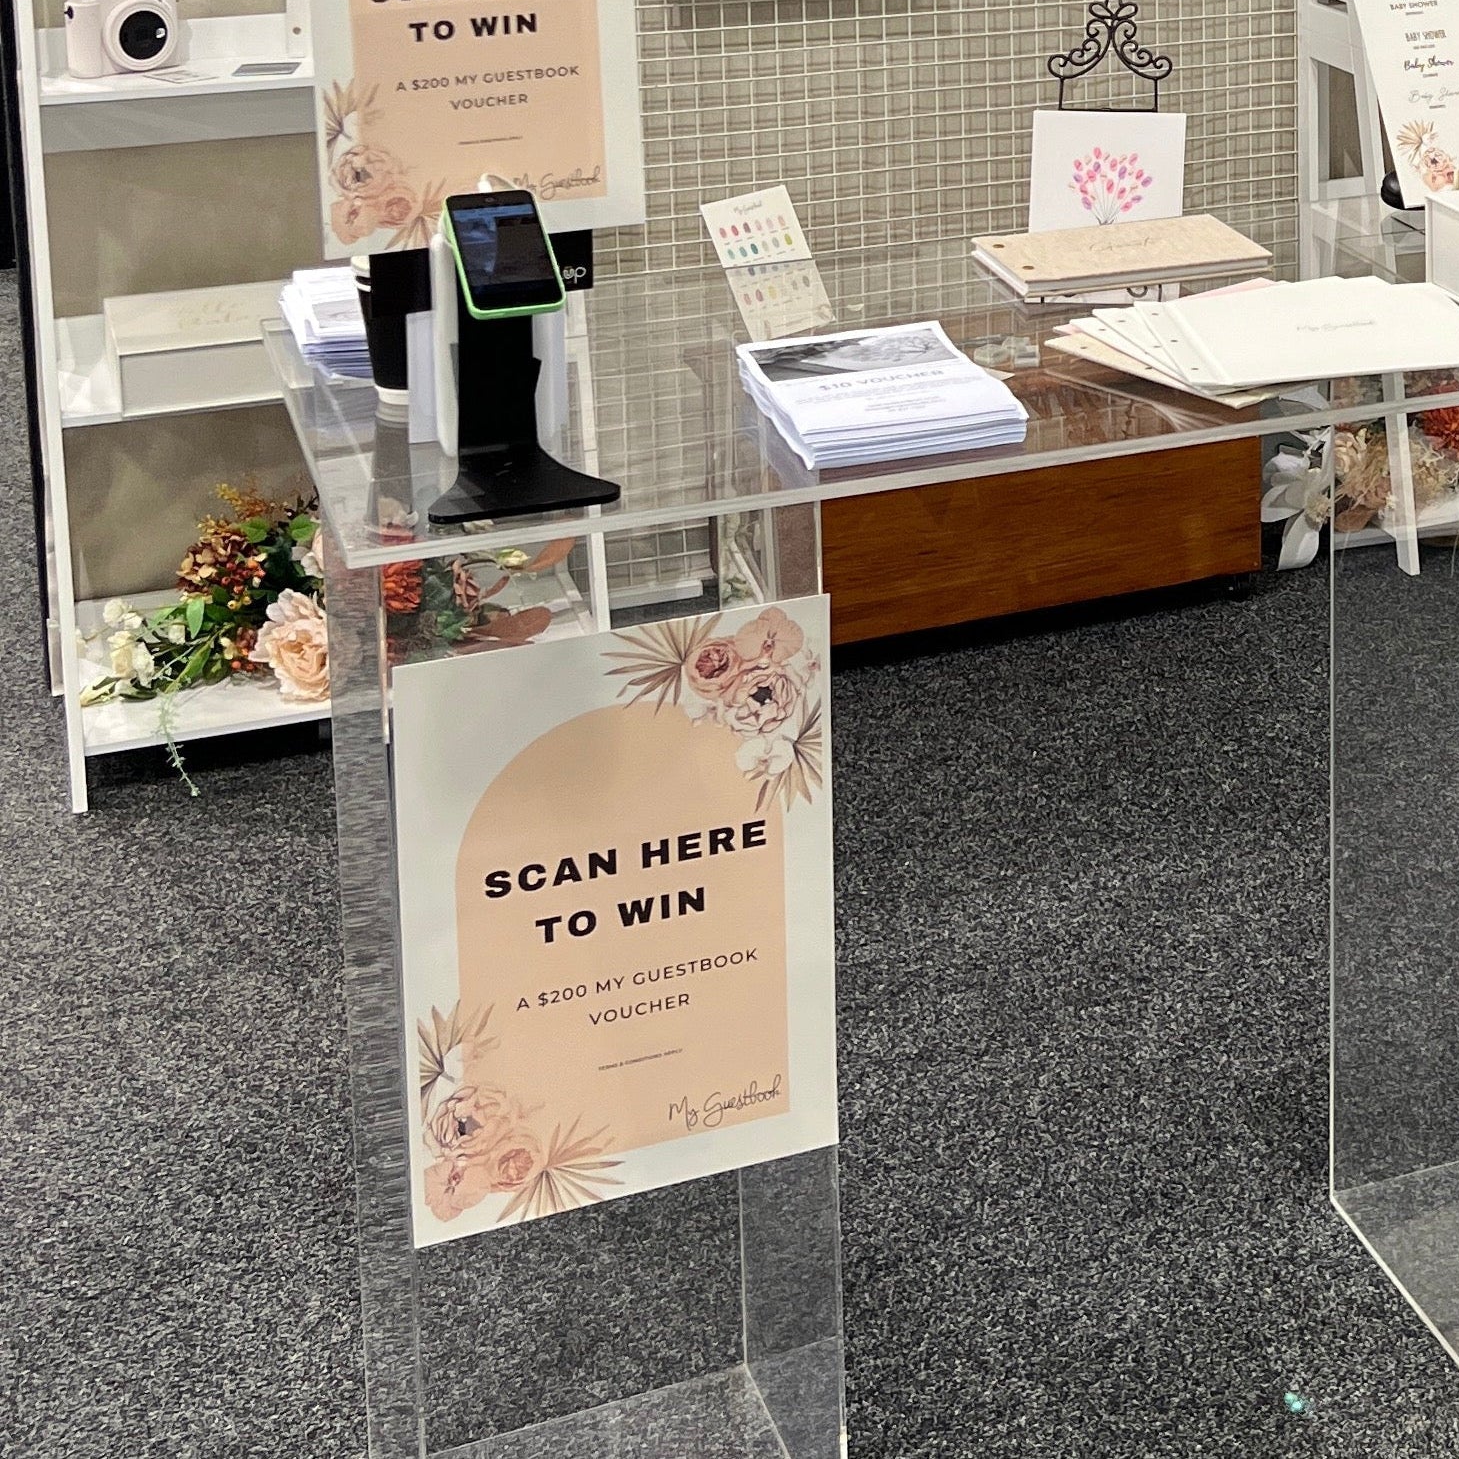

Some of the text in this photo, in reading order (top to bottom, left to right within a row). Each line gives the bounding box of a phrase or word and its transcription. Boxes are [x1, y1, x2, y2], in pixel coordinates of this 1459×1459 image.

[409, 13, 537, 42] TO WIN
[396, 65, 580, 92] A $200 MY GUESTBOOK
[450, 93, 529, 110] VOUCHER
[541, 165, 601, 200] Guestbook
[820, 370, 944, 391] $10 VOUCHER
[484, 819, 768, 900] SCAN HERE
[535, 886, 706, 944] TO WIN
[516, 947, 760, 1012] A $200 MY GUESTBOOK
[589, 993, 692, 1026] VOUCHER
[598, 1062, 618, 1071] TERMS
[624, 1053, 662, 1065] CONDITIONS
[668, 1073, 782, 1130] My Guestbook
